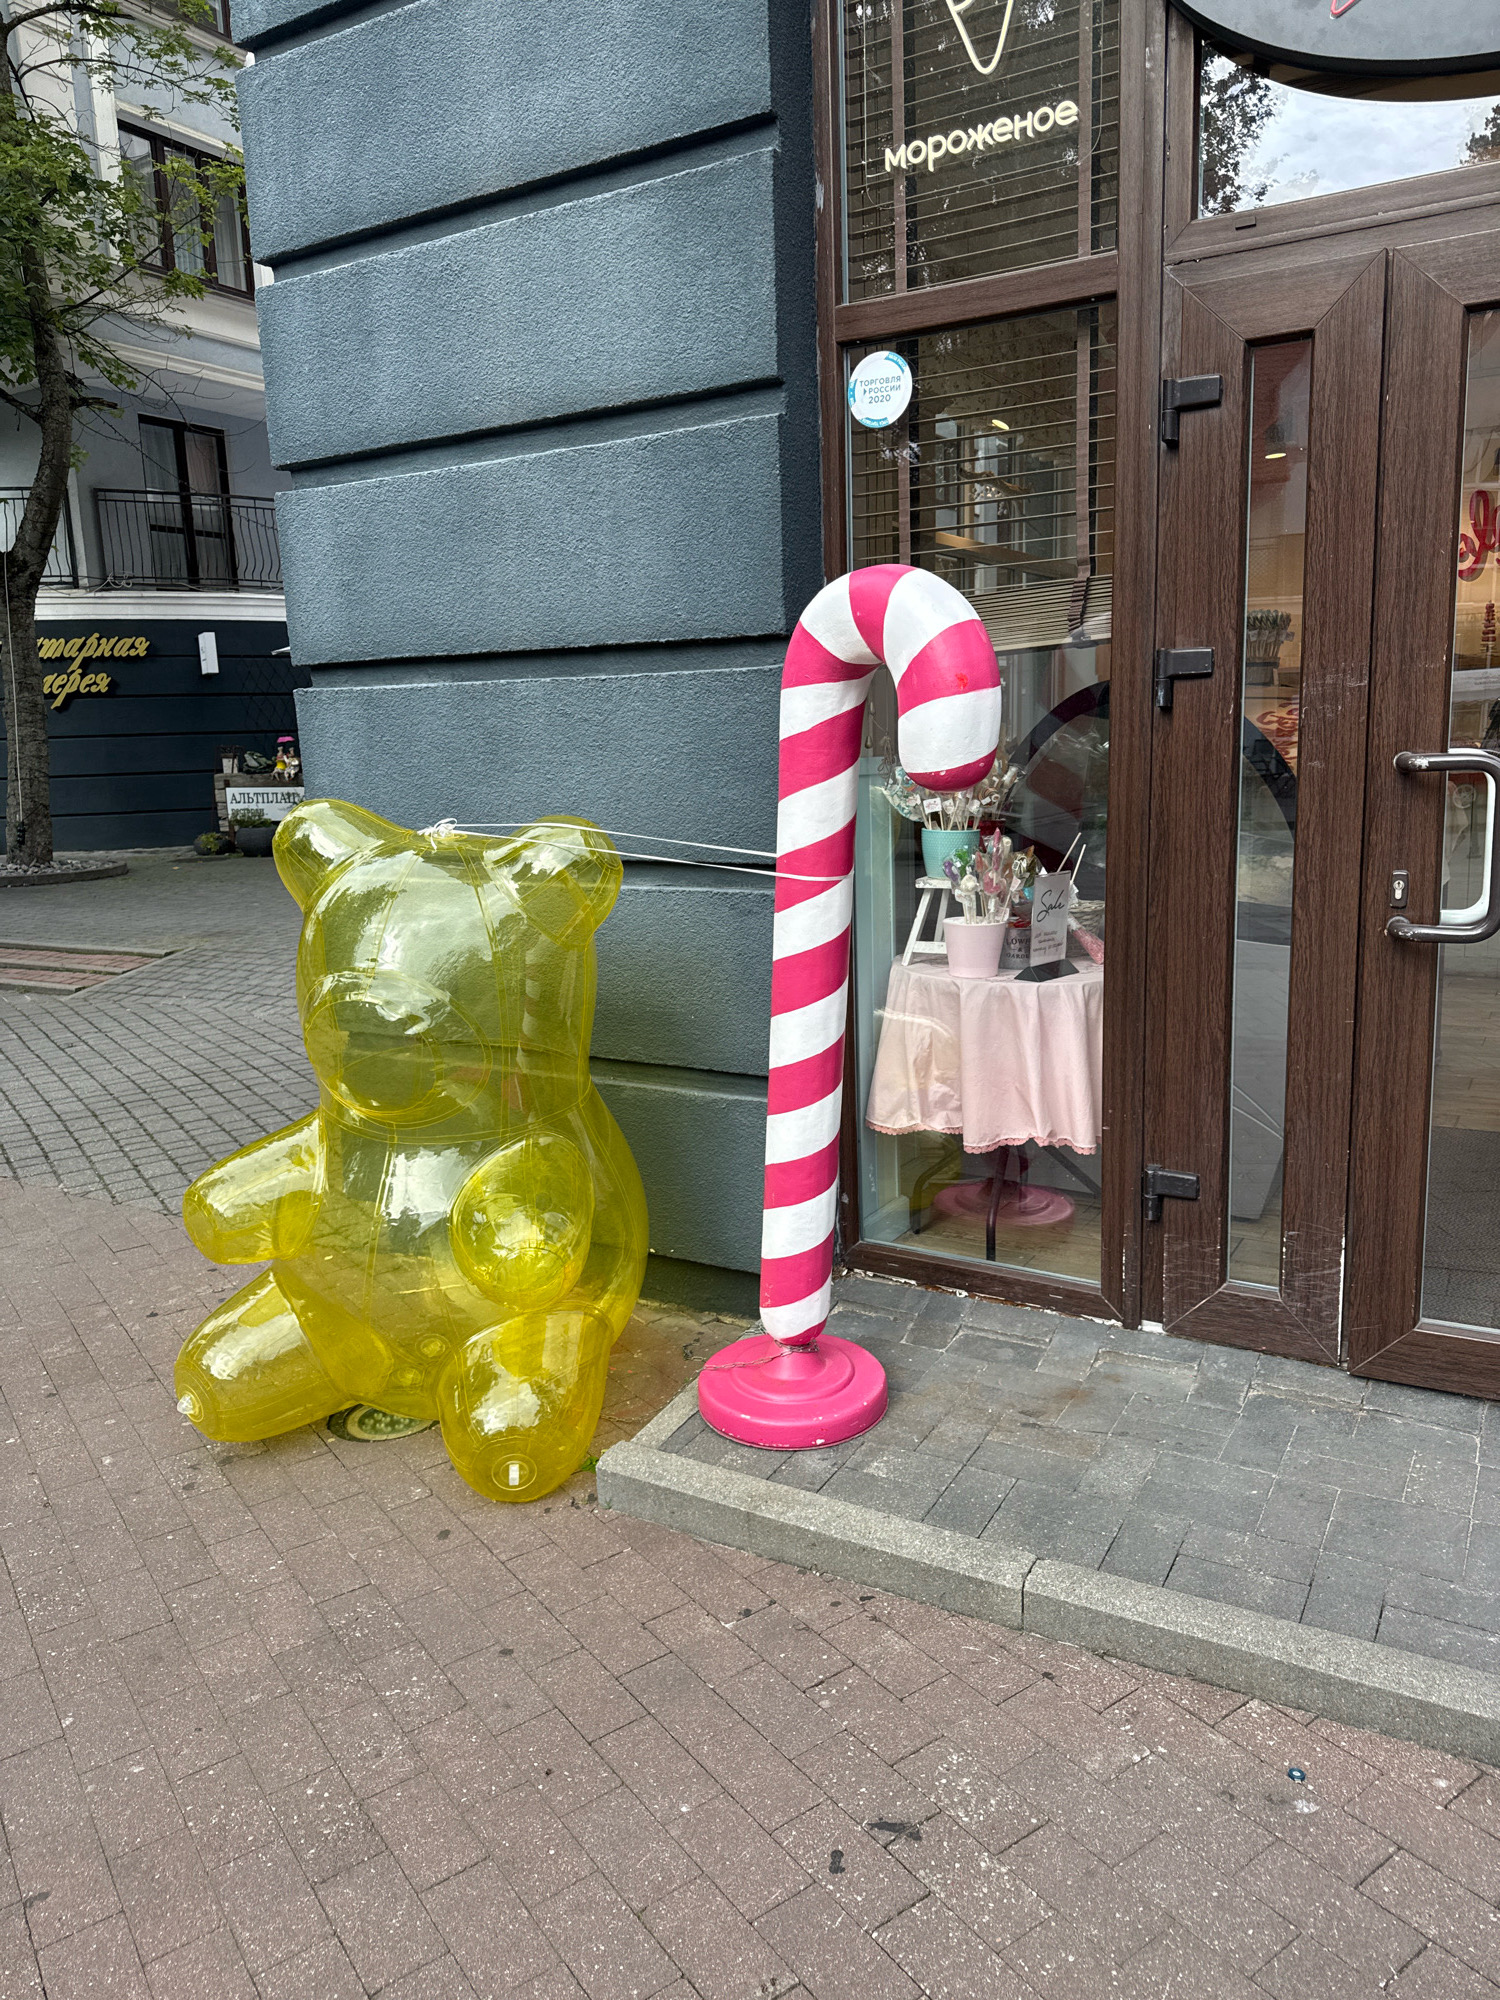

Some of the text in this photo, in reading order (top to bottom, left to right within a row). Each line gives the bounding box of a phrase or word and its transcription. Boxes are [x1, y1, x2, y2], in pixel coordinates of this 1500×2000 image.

[884, 100, 1079, 172] мороженое
[860, 375, 901, 387] ТОРГОВЛЯ
[868, 385, 901, 394] РОССИИ
[868, 394, 891, 404] 2020
[1036, 889, 1065, 922] Sale
